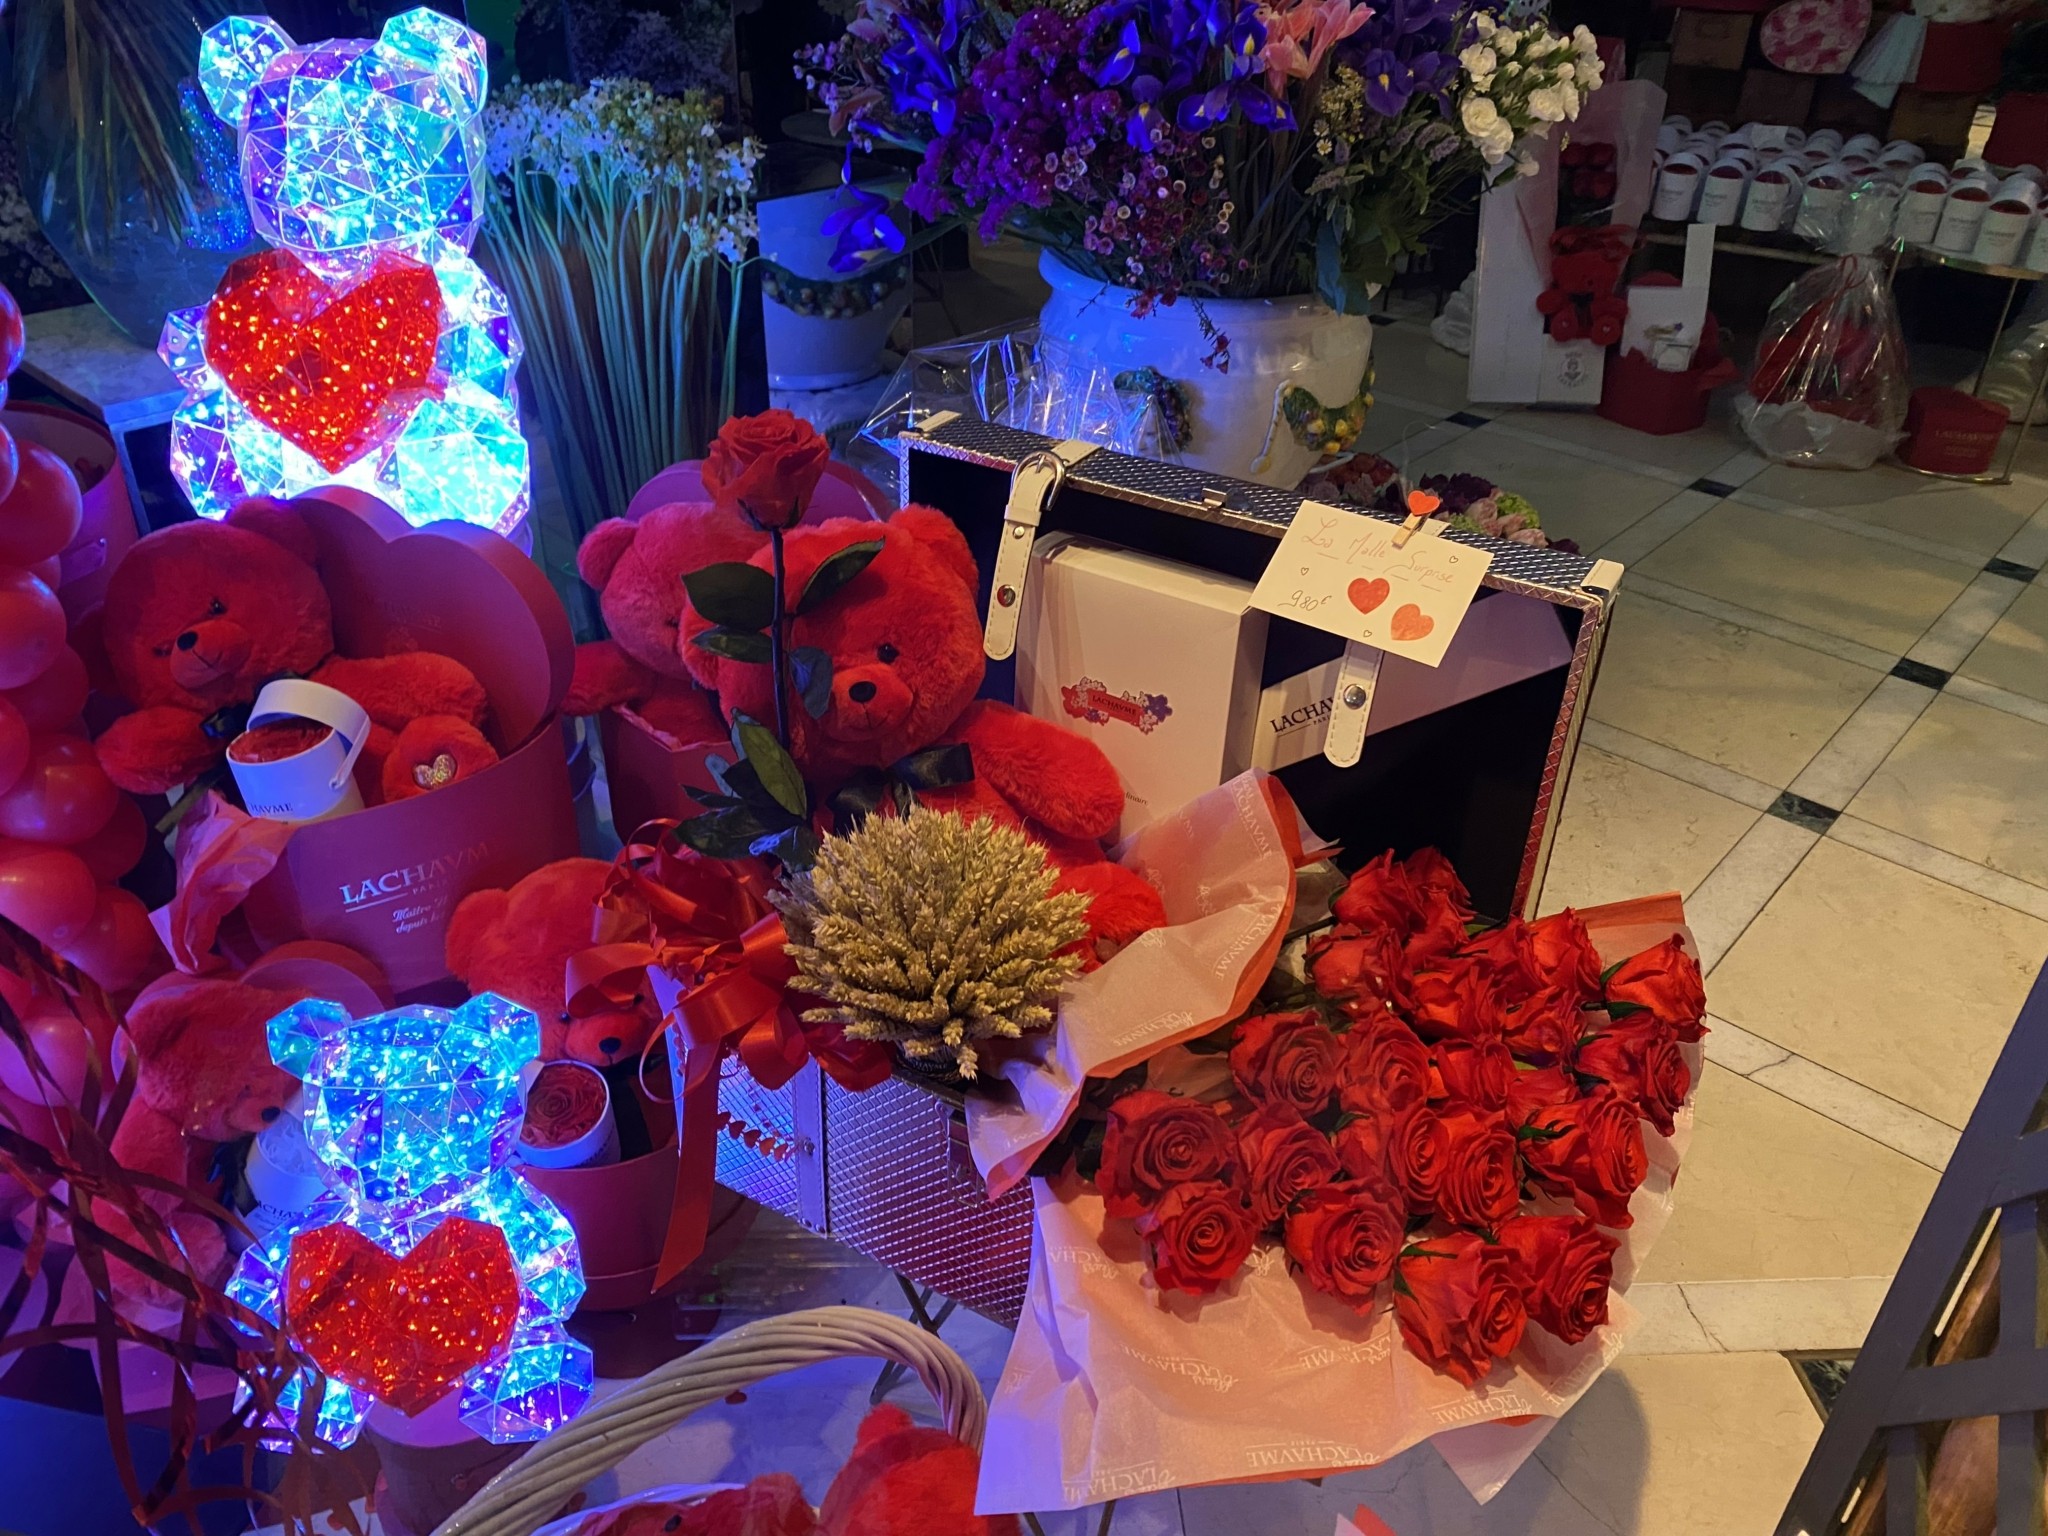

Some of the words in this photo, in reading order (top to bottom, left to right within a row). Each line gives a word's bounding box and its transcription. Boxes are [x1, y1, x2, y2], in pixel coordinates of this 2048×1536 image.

[1301, 517, 1337, 549] La
[1346, 531, 1386, 564] Malle
[1383, 551, 1455, 584] Surprise
[1232, 781, 1273, 859] LACHAVME
[338, 840, 489, 905] LACHAVM
[1119, 1344, 1222, 1377] LACHAVME
[1431, 1393, 1524, 1425] LACHAVME
[1246, 1445, 1362, 1468] LACHAVME
